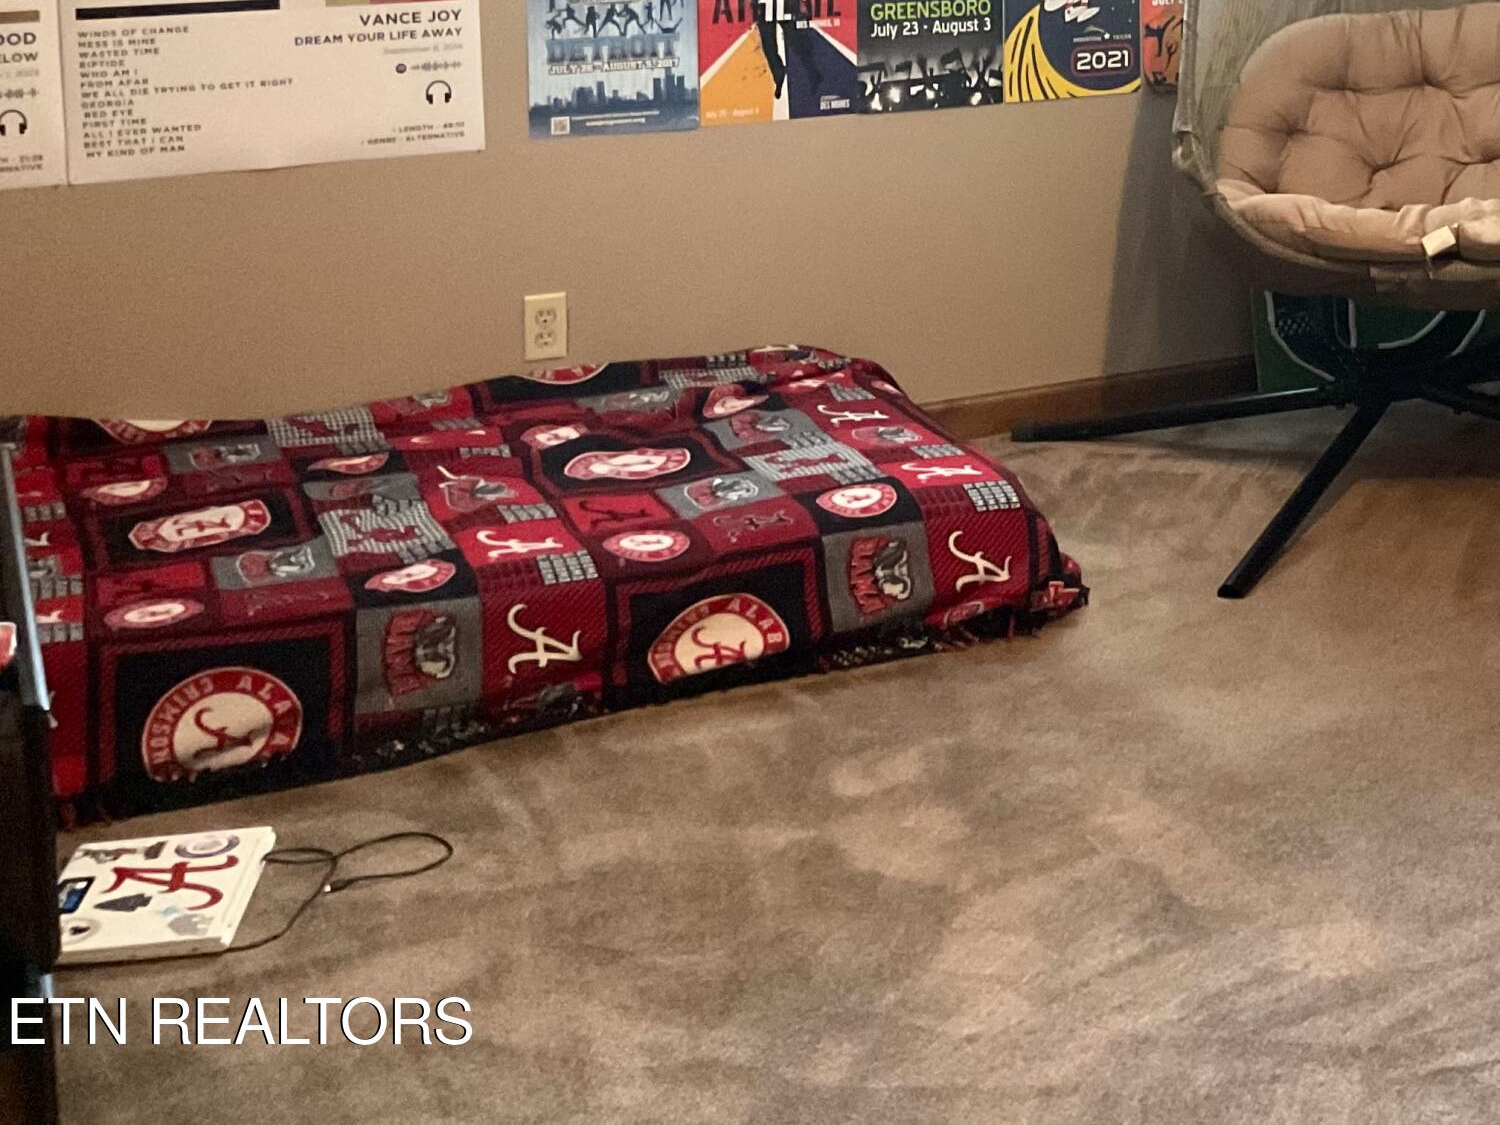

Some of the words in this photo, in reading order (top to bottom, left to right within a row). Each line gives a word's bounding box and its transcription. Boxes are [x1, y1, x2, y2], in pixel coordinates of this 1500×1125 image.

[359, 11, 421, 26] VANCE
[428, 10, 461, 23] JOY
[78, 30, 117, 38] WINDS
[142, 26, 189, 35] CHANGE
[871, 22, 897, 40] July
[902, 22, 919, 35] 23
[932, 17, 977, 35] August
[983, 17, 991, 31] 3
[295, 34, 343, 46] DREAM
[347, 32, 385, 43] YOUR
[390, 30, 417, 40] LIFE
[422, 28, 462, 38] AWAY
[78, 40, 108, 48] MESS
[128, 38, 156, 46] MINE
[79, 49, 129, 59] WASTED
[134, 47, 160, 55] TIME
[80, 60, 125, 68] RIPTIDE
[1076, 50, 1130, 71] 2021
[603, 61, 643, 72] AUGUST
[113, 69, 130, 77] AM
[80, 80, 113, 89] FROM
[130, 88, 149, 96] DIE
[154, 85, 196, 94] TRYING
[202, 83, 216, 91] TO
[221, 82, 241, 90] GET
[260, 79, 293, 88] RIGHT
[81, 100, 135, 108] GEORGIA
[84, 111, 107, 119] RED
[83, 121, 114, 129] FIRST
[84, 131, 105, 139] ALL
[152, 125, 202, 134] WANTED
[84, 141, 112, 149] BEST
[108, 148, 135, 156] KIND
